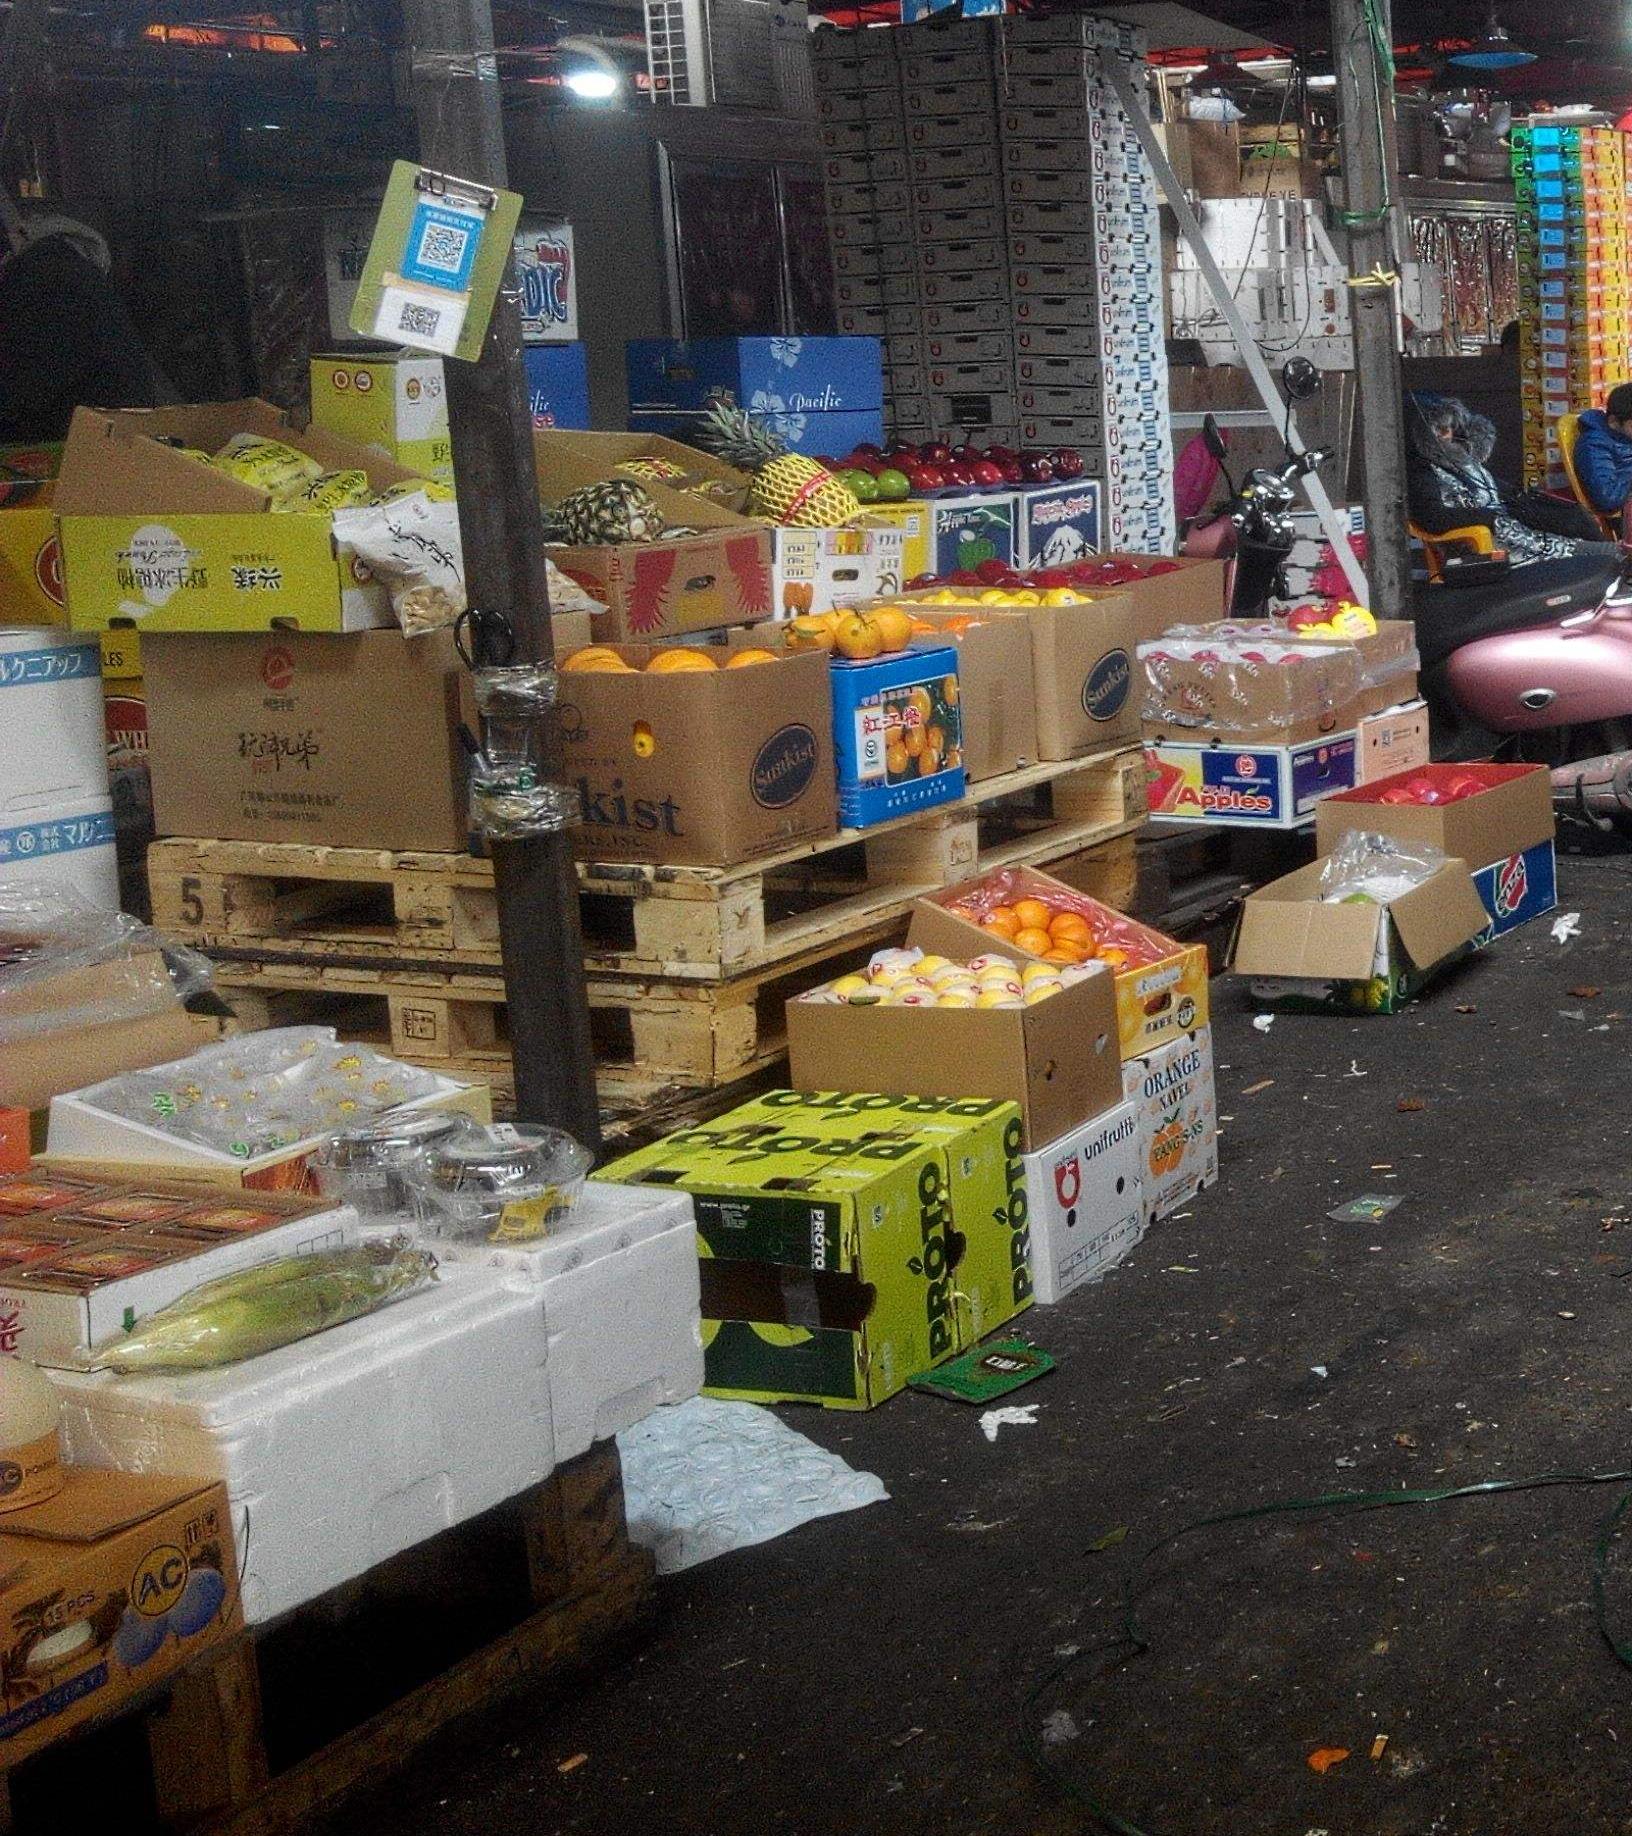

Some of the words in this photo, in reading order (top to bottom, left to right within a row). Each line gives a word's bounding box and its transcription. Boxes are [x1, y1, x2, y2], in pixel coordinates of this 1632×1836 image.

[789, 384, 842, 412] Pacific
[756, 744, 816, 788] Sunkist
[577, 776, 684, 837] kist
[1175, 786, 1273, 812] Apples
[181, 876, 204, 926] 5
[1143, 1049, 1201, 1098] ORANGE
[1084, 1116, 1133, 1161] unifrutti
[810, 1209, 826, 1271] PROTO
[918, 1161, 951, 1361] PROTO
[138, 1556, 183, 1606] AC
